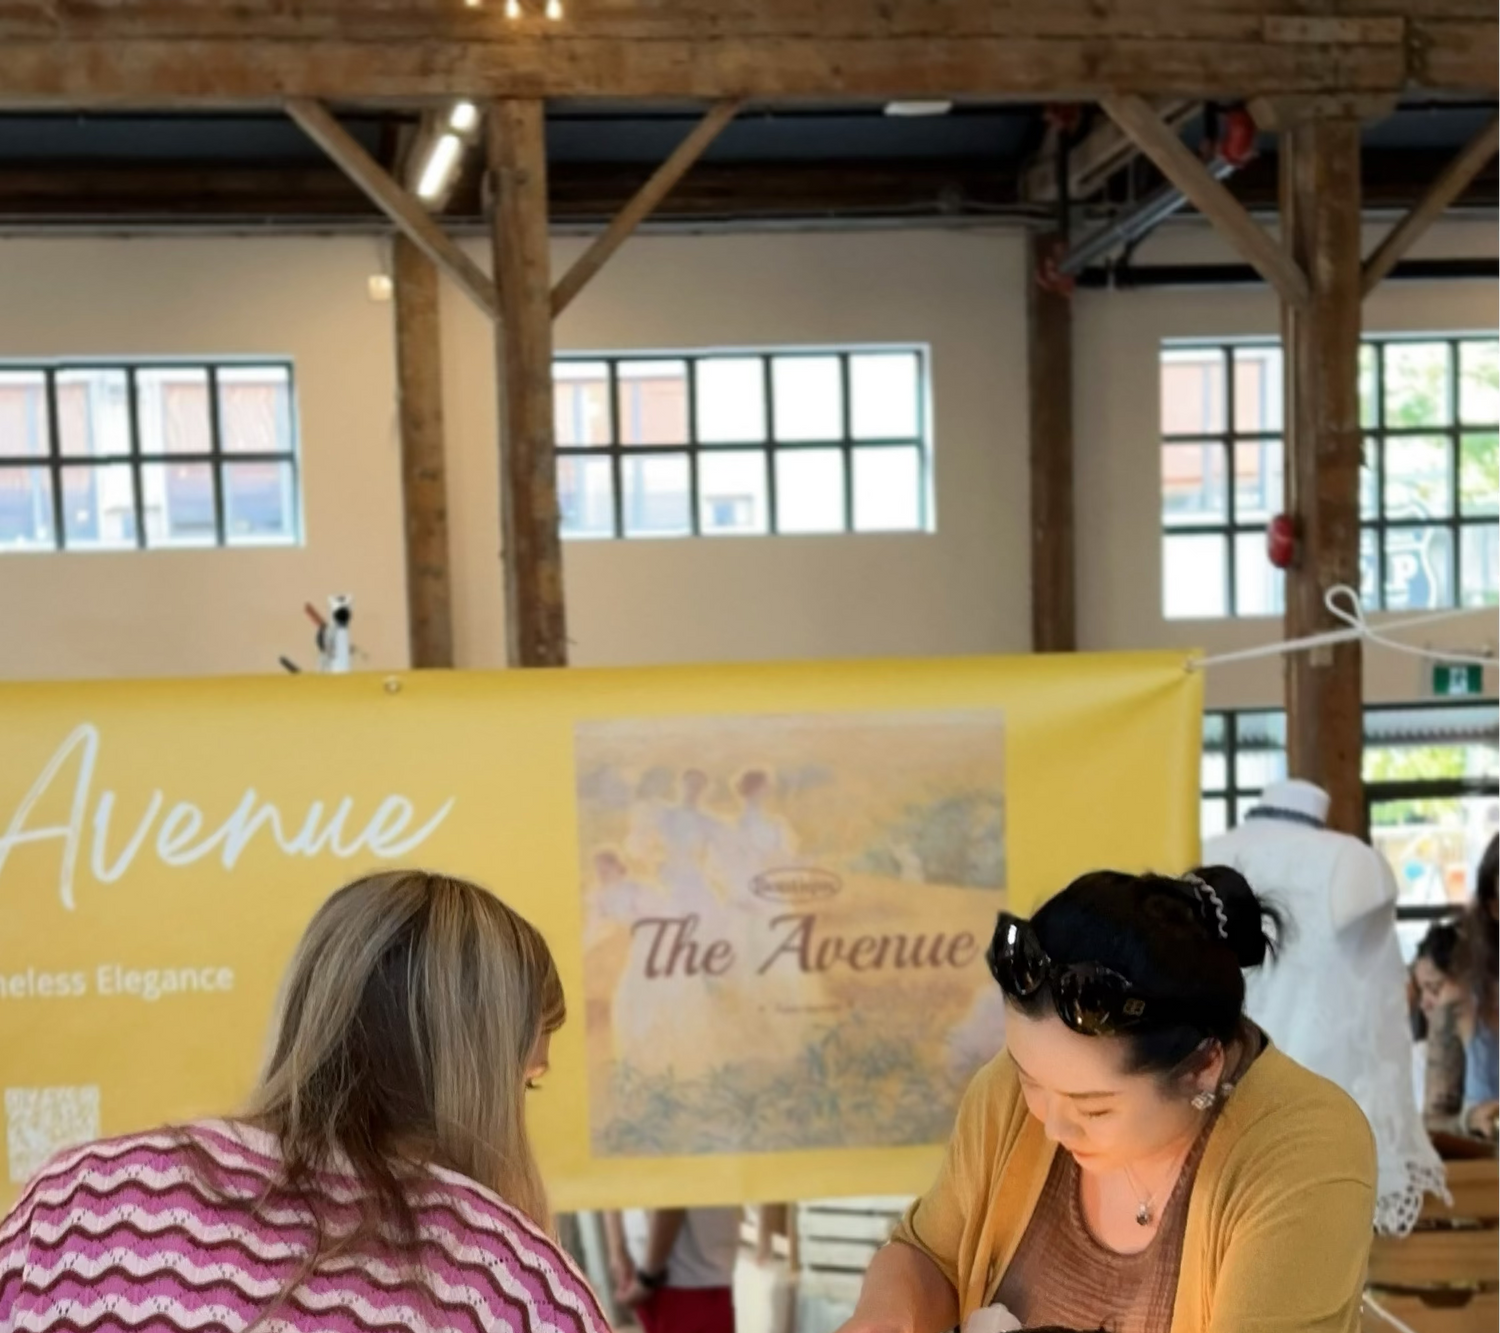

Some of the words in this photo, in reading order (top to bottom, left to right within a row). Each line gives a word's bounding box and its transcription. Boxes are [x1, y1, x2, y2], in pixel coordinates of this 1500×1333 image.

[0, 723, 456, 911] Avenue
[630, 913, 736, 980] The
[757, 913, 980, 977] Avenue
[0, 965, 87, 998] eless
[96, 963, 235, 1002] Elegance
